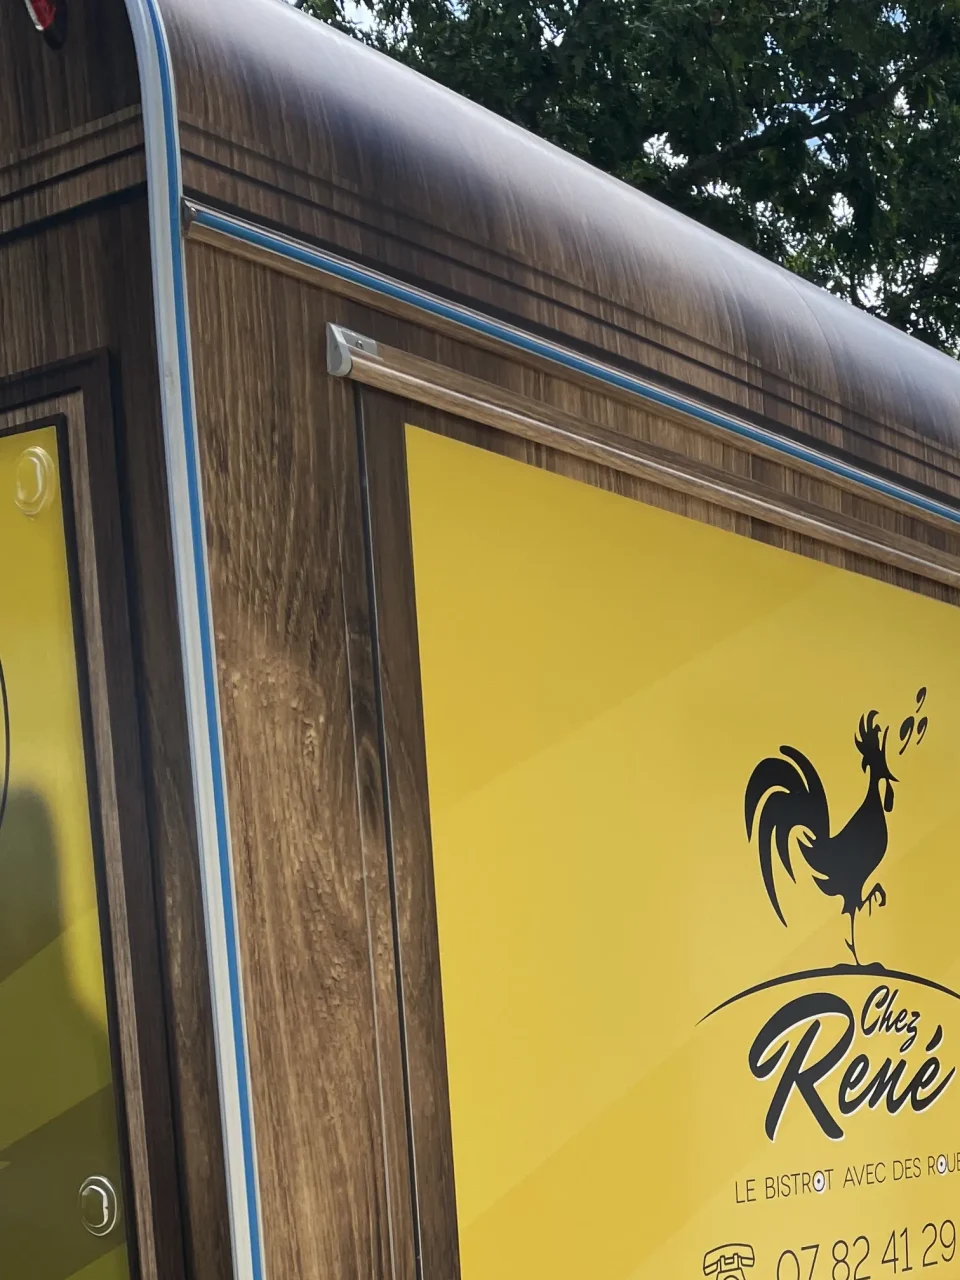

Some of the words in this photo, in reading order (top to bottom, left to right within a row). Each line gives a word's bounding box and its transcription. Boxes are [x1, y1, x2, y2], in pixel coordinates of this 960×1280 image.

[861, 985, 920, 1053] Chez
[748, 992, 956, 1142] René
[735, 1179, 757, 1204] LE
[765, 1168, 834, 1201] BISTROT
[843, 1162, 887, 1189] AVEC
[893, 1157, 922, 1181] DES
[881, 1227, 913, 1275] 41
[921, 1219, 957, 1268] 29
